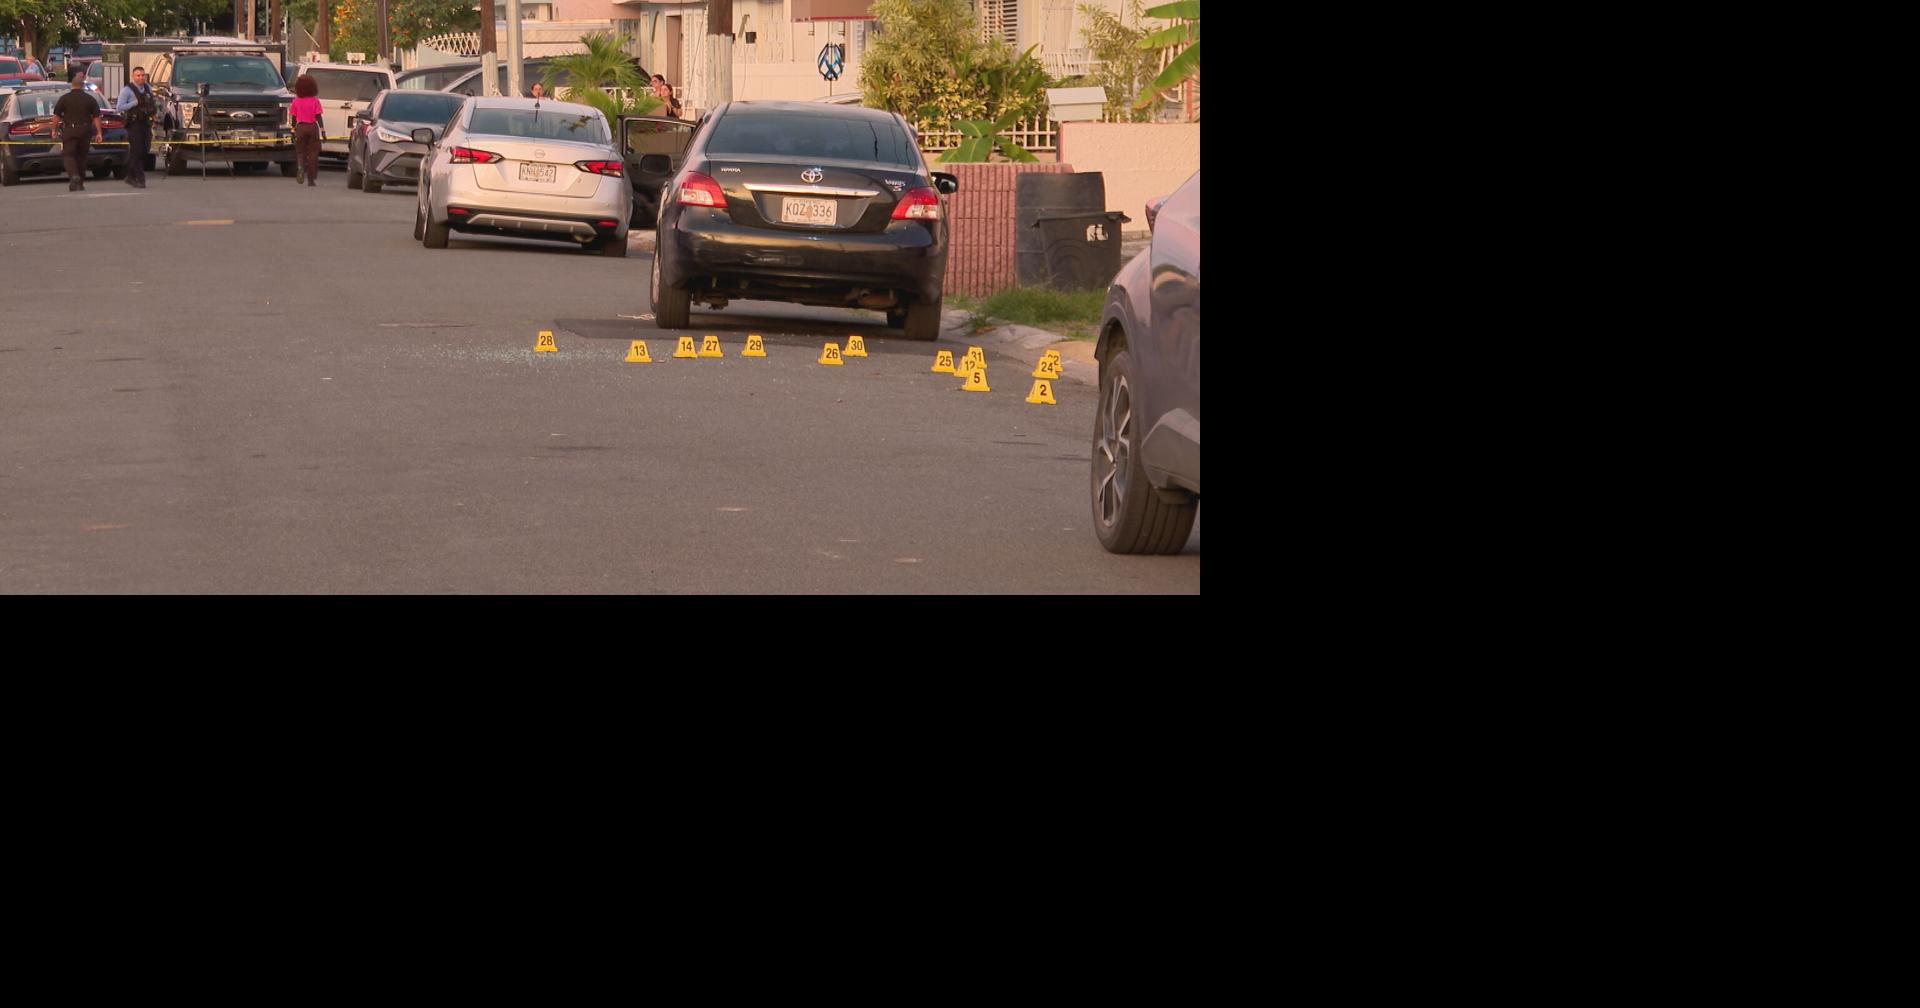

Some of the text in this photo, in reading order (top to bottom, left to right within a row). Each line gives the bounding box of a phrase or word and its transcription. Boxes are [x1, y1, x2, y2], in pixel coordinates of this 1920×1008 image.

[812, 204, 832, 217] 336
[540, 335, 553, 346] 28
[681, 341, 692, 352] 14
[705, 340, 718, 352] 27
[749, 340, 762, 351] 29
[850, 339, 863, 351] 30
[634, 345, 646, 357] 13
[825, 347, 839, 360] 26
[971, 350, 982, 362] 31
[939, 355, 952, 367] 25
[1041, 361, 1054, 373] 24
[973, 371, 981, 384] 5
[1039, 384, 1048, 396] 2
